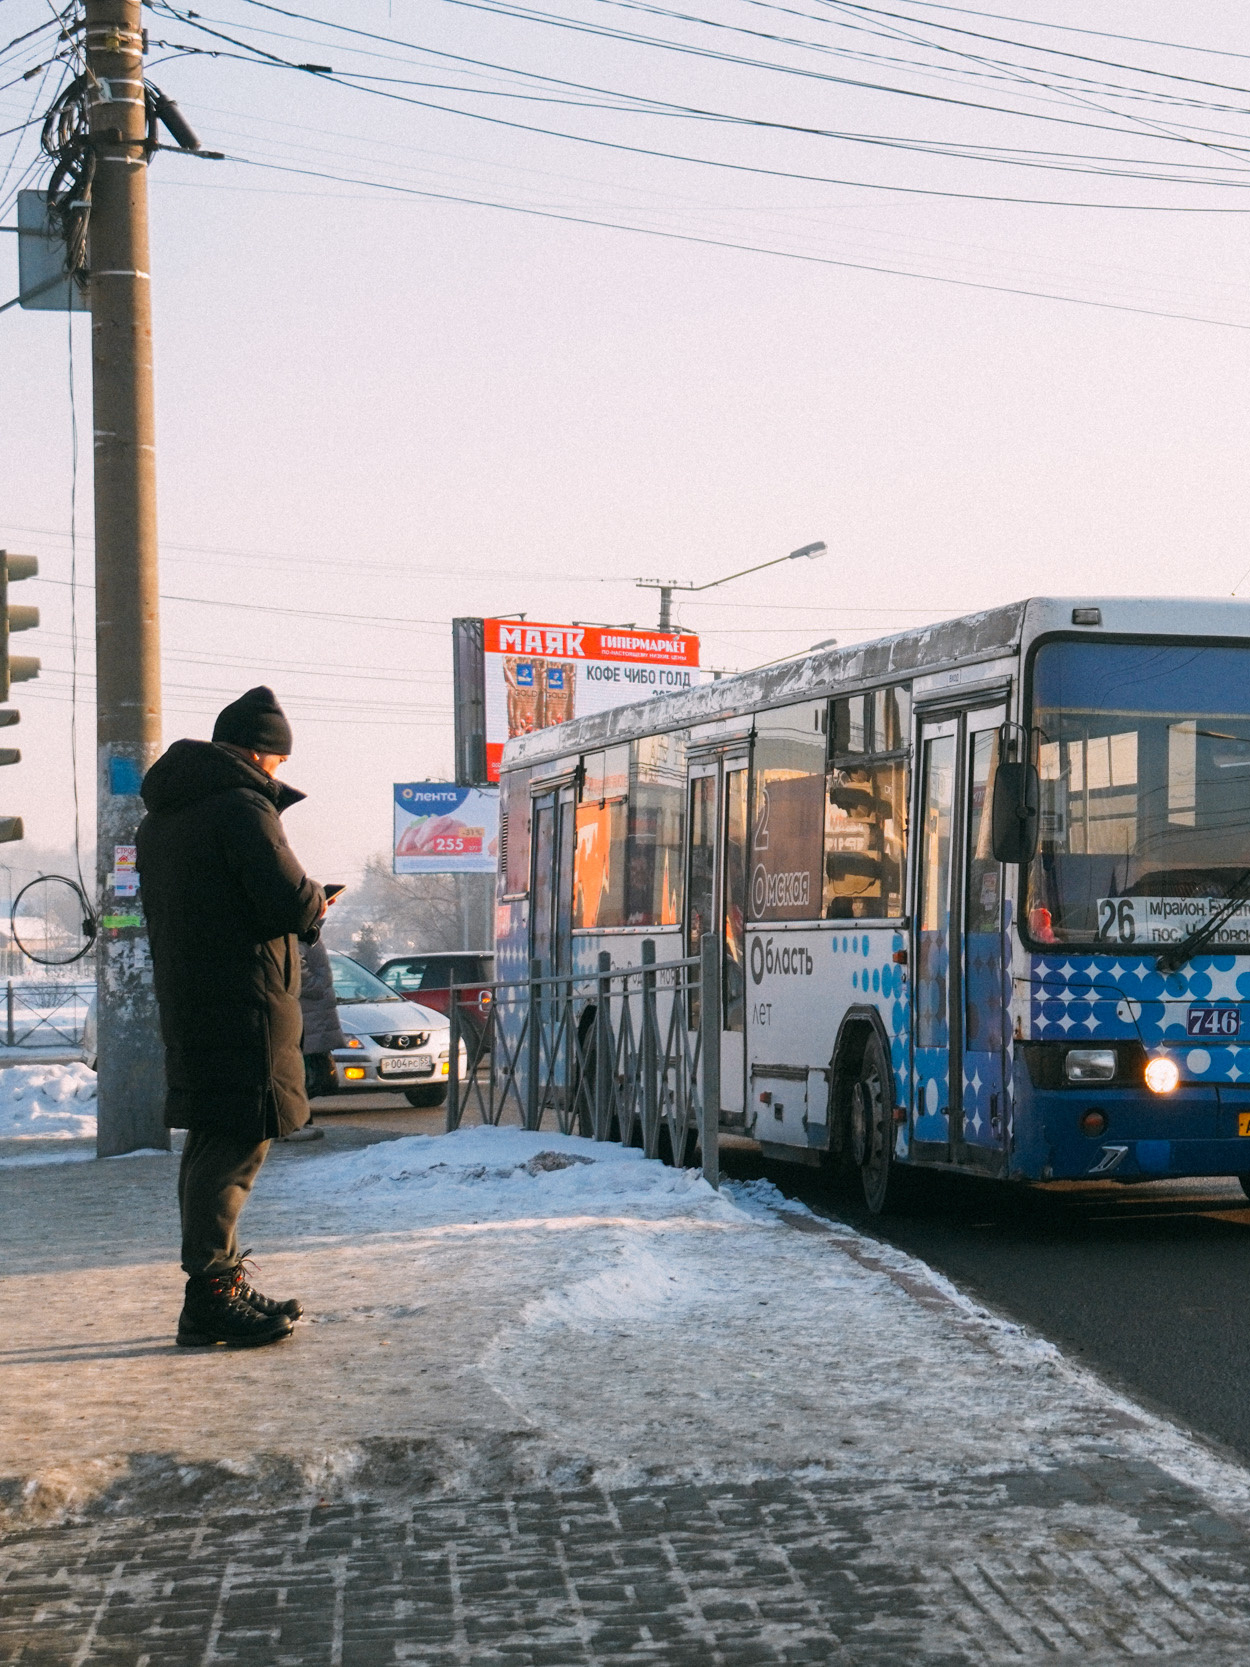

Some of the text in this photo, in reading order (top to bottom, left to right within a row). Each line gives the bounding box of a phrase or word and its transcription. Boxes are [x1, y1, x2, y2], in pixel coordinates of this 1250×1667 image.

[499, 626, 586, 657] МАЯК
[601, 634, 686, 654] ГИПЕРМАРКЕТ
[586, 665, 691, 689] КОФЕ ЧИБО ГОЛД
[414, 792, 457, 802] лента
[435, 838, 464, 851] 255
[751, 863, 810, 919] Омская
[1100, 899, 1136, 944] 26
[1152, 927, 1182, 943] пос.
[751, 935, 814, 985] Область
[752, 1003, 773, 1027] лет
[1189, 1010, 1238, 1034] 746
